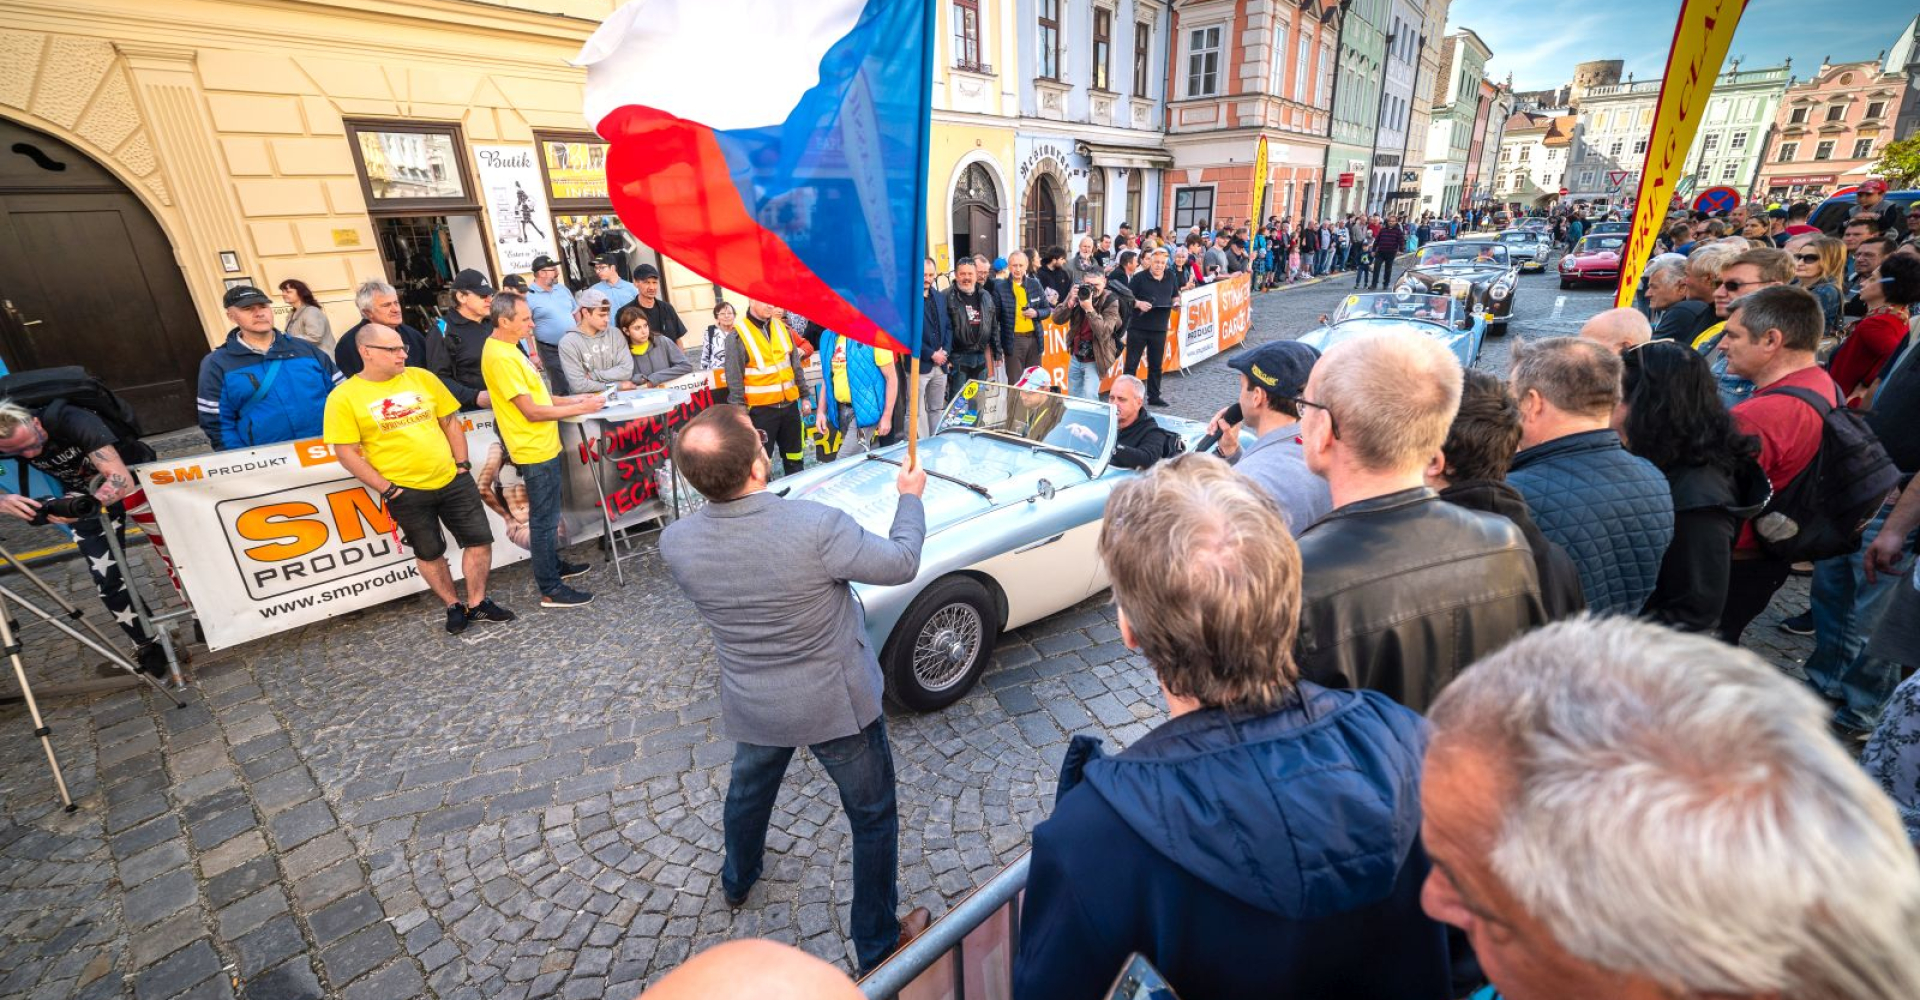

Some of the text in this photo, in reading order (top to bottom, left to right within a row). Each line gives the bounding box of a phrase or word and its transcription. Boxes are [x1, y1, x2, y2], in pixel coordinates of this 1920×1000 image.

[479, 149, 533, 169] Butik
[1625, 126, 1676, 287] SPRING
[1187, 300, 1213, 331] SM
[149, 456, 288, 486] SM PRODUKT
[595, 475, 659, 522] TECH
[235, 485, 398, 562] SM
[252, 537, 393, 589] PRODU
[258, 564, 420, 619] www.smproduk
